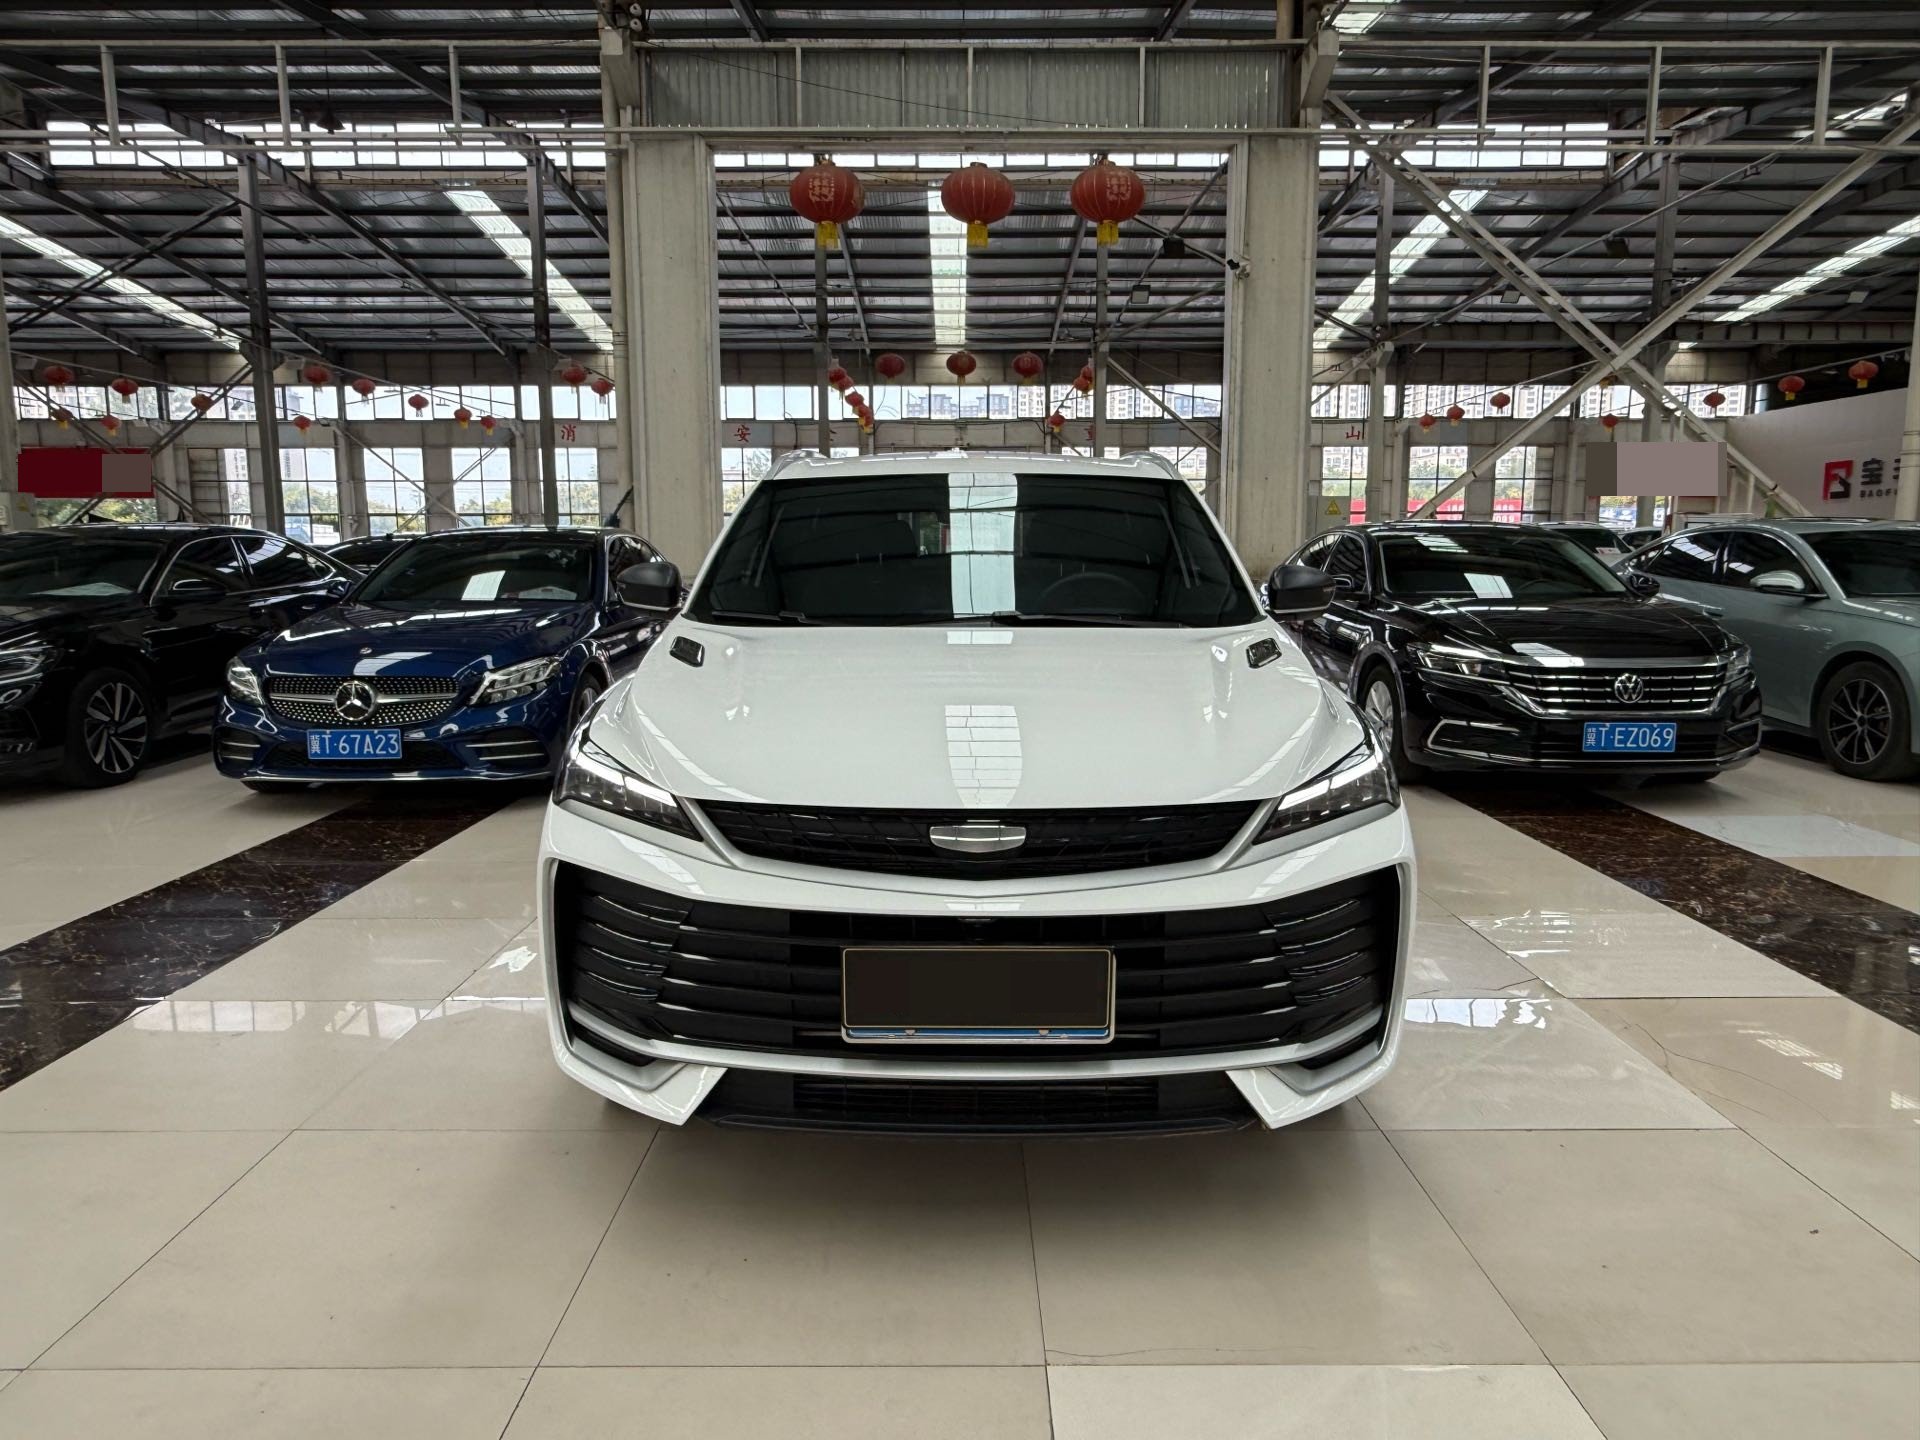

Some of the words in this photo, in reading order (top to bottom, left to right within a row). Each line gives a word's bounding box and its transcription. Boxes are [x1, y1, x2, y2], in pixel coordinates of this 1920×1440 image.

[560, 424, 577, 442] 消
[733, 424, 751, 443] 安
[1346, 426, 1361, 440] 山
[1861, 458, 1901, 485] 宝
